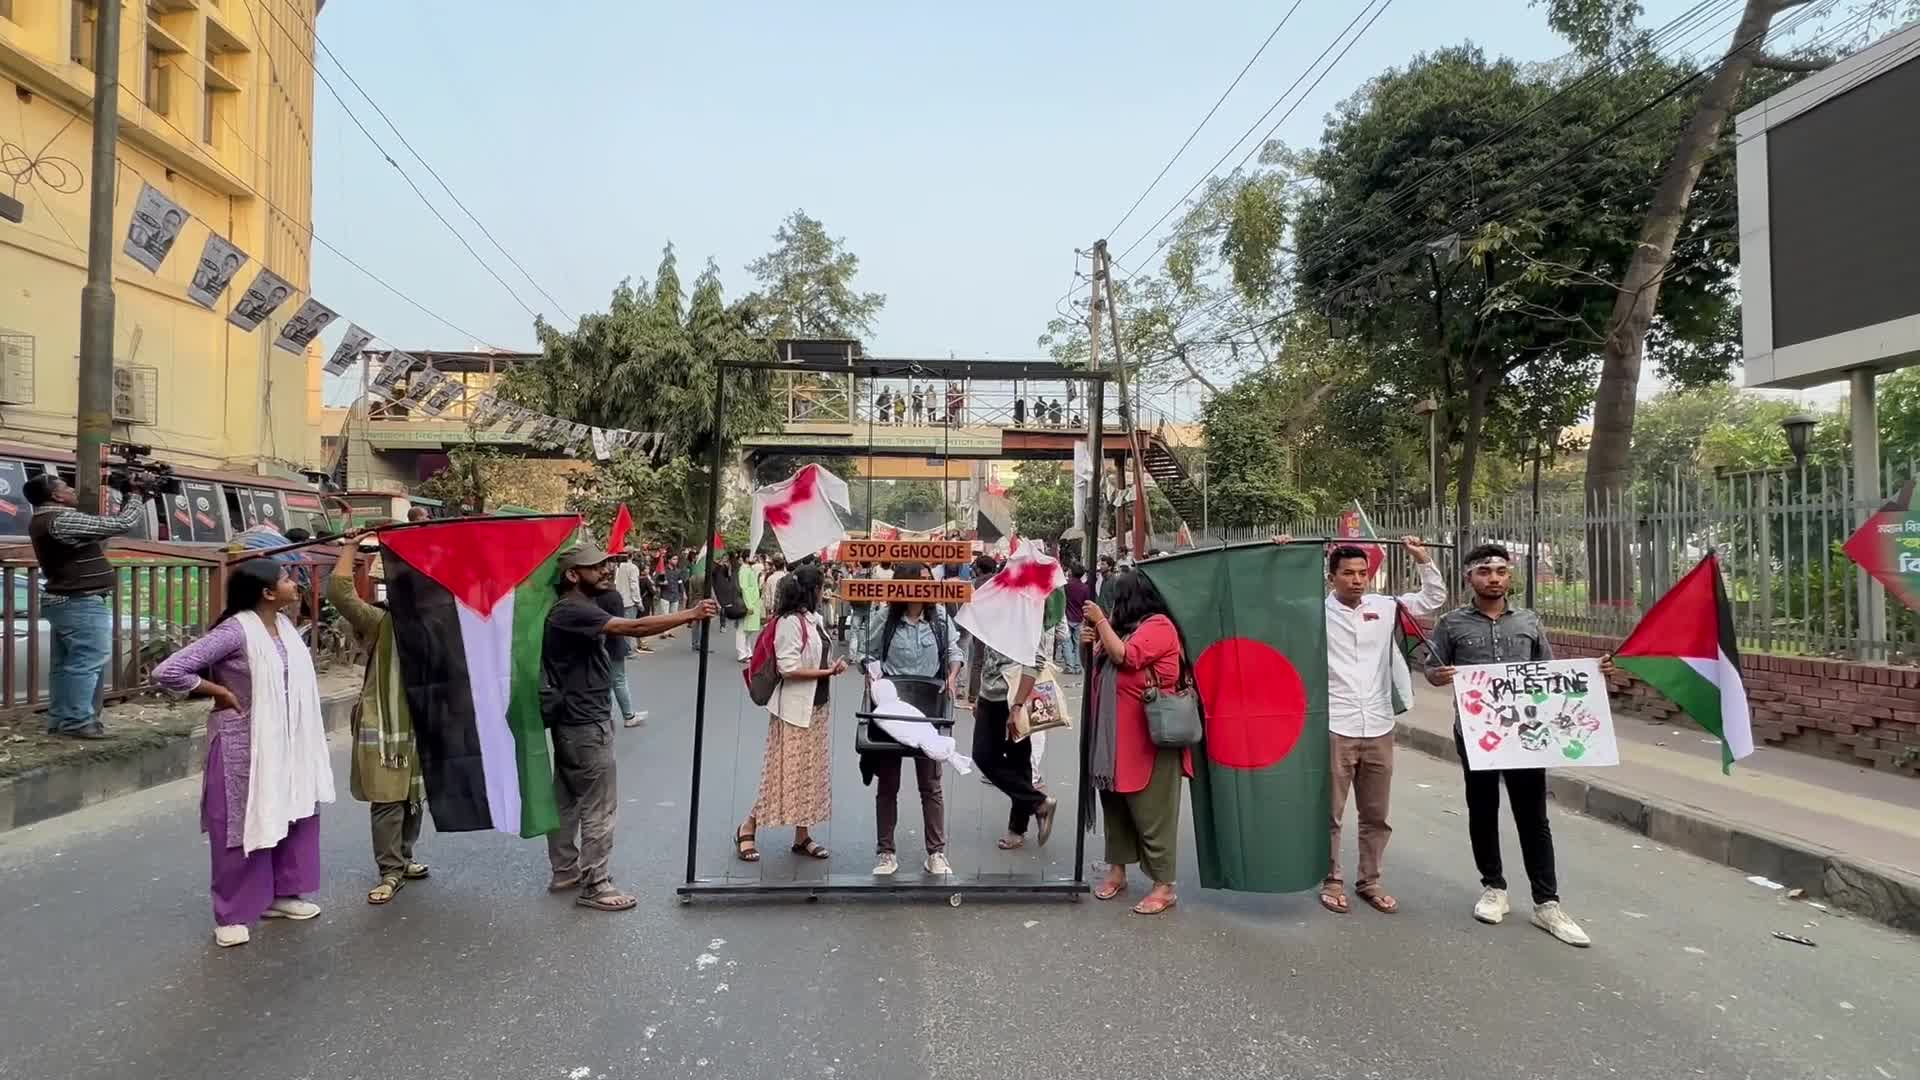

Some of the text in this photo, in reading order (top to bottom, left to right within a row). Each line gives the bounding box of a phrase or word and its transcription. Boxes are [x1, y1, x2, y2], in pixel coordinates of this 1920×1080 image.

[850, 543, 964, 559] STOP GENOCIDE
[849, 584, 964, 599] FREE PALESTINE
[1505, 662, 1548, 677] FREE
[1489, 671, 1589, 701] PALESTINE
